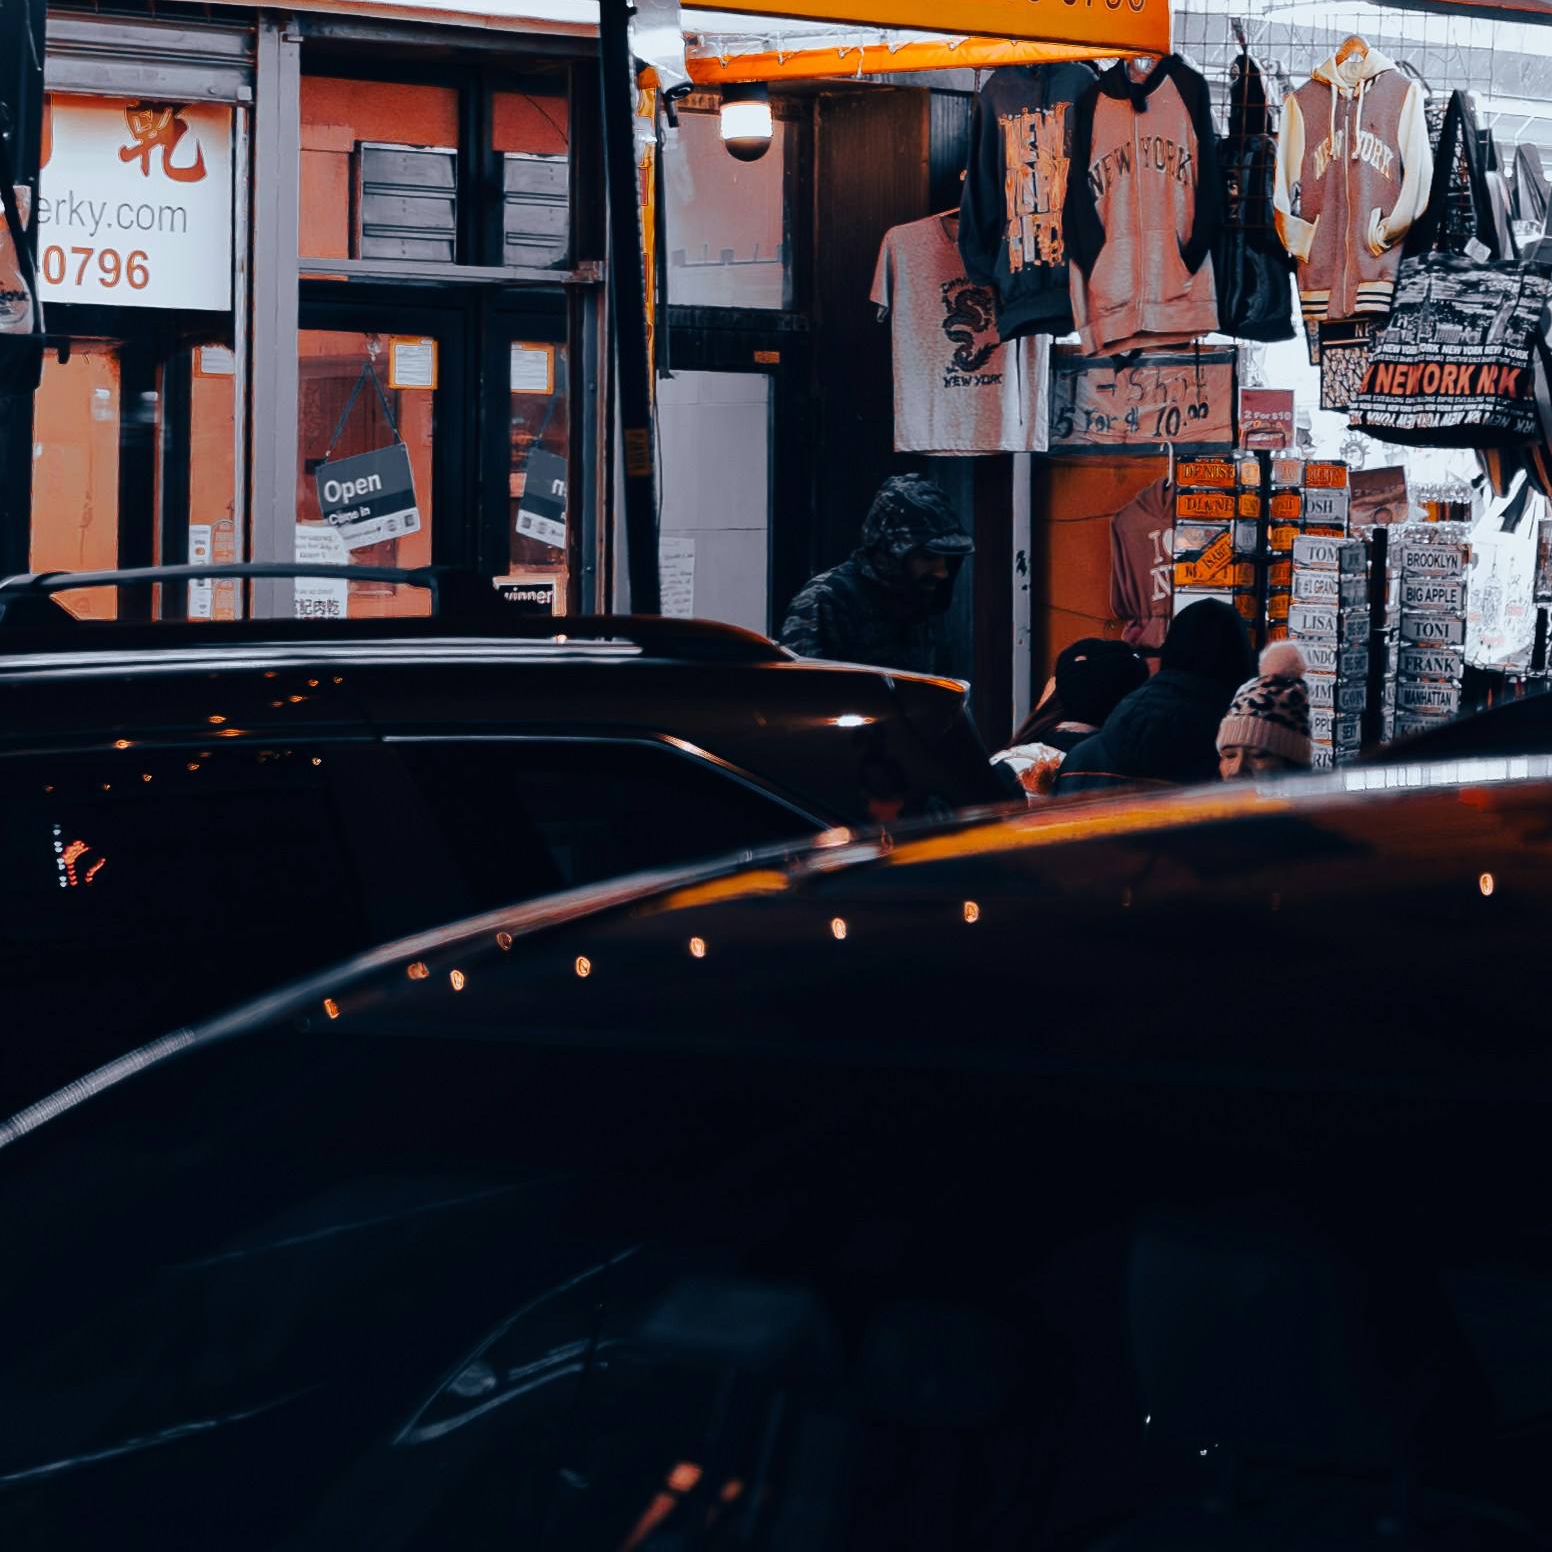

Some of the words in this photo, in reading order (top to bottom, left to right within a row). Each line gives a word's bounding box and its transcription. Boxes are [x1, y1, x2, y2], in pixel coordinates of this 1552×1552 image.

[1088, 142, 1133, 197] NEW
[1140, 136, 1193, 186] YORK
[1441, 344, 1461, 355] NEW
[1504, 347, 1529, 361] YORK
[1423, 363, 1476, 395] ORK
[1054, 406, 1076, 438] 5
[1243, 410, 1253, 420] 2
[323, 473, 383, 505] Open
[1186, 497, 1234, 512] DIANE
[1406, 552, 1458, 569] BROOKLYN
[1406, 586, 1423, 603] BIG
[1425, 588, 1457, 604] APPLE
[1302, 614, 1334, 631] LISA
[1413, 621, 1449, 638] TONI
[1404, 655, 1455, 673] FRANK
[1404, 689, 1452, 706] MANHATTAN
